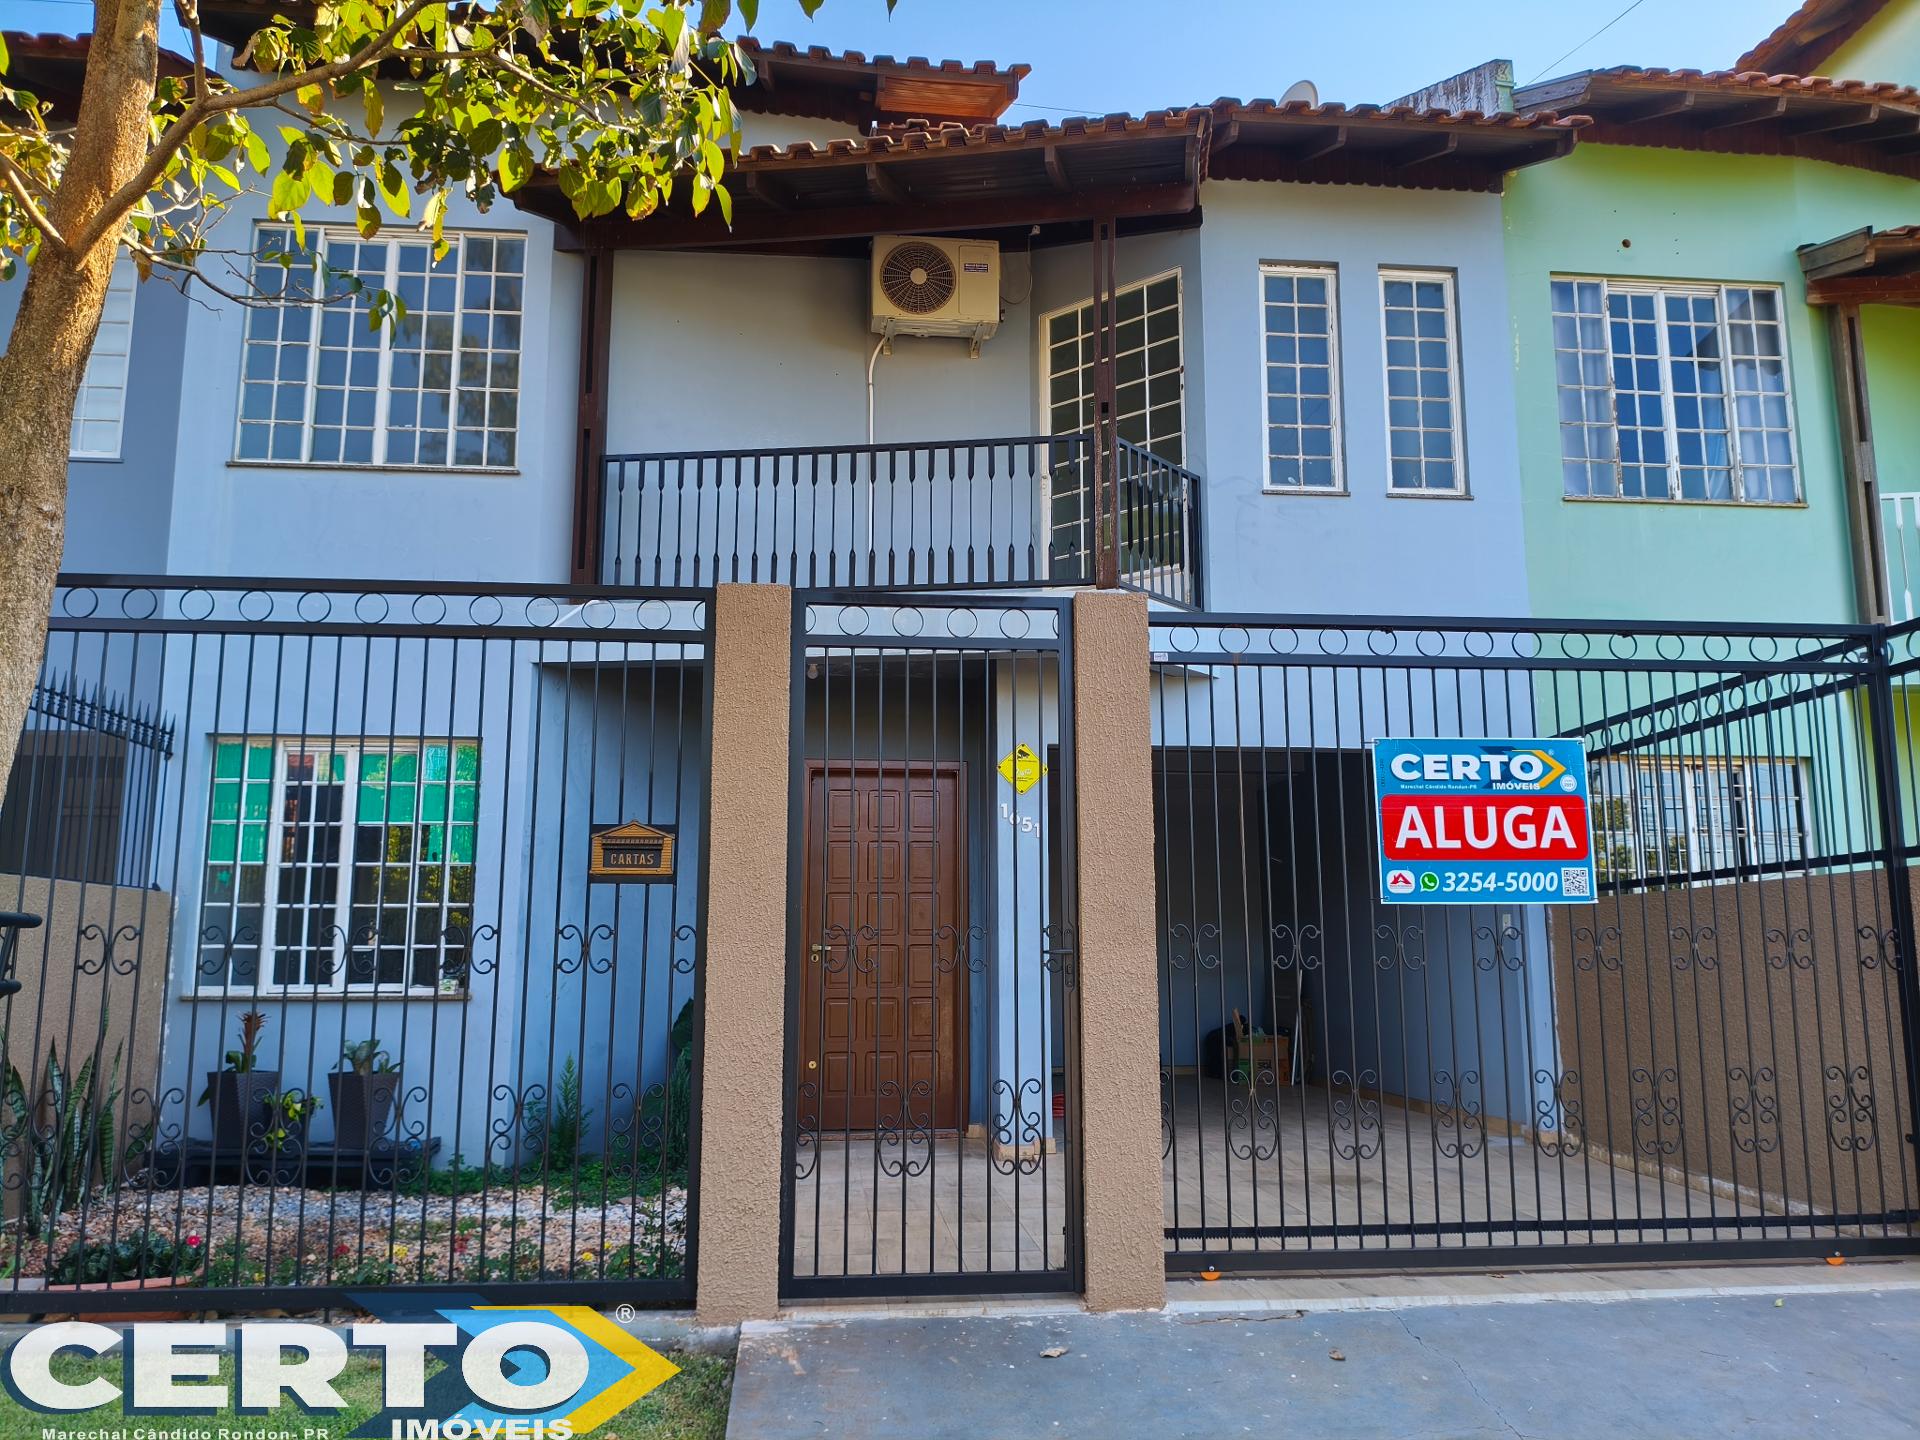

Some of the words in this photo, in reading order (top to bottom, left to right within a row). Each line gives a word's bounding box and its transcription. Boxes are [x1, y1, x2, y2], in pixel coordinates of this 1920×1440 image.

[1390, 753, 1543, 781] CERTO
[1492, 781, 1541, 790] IMÓVEIS
[1395, 805, 1577, 849] ALUGA
[610, 853, 655, 865] CARTAS
[1442, 872, 1559, 892] 3254-5000
